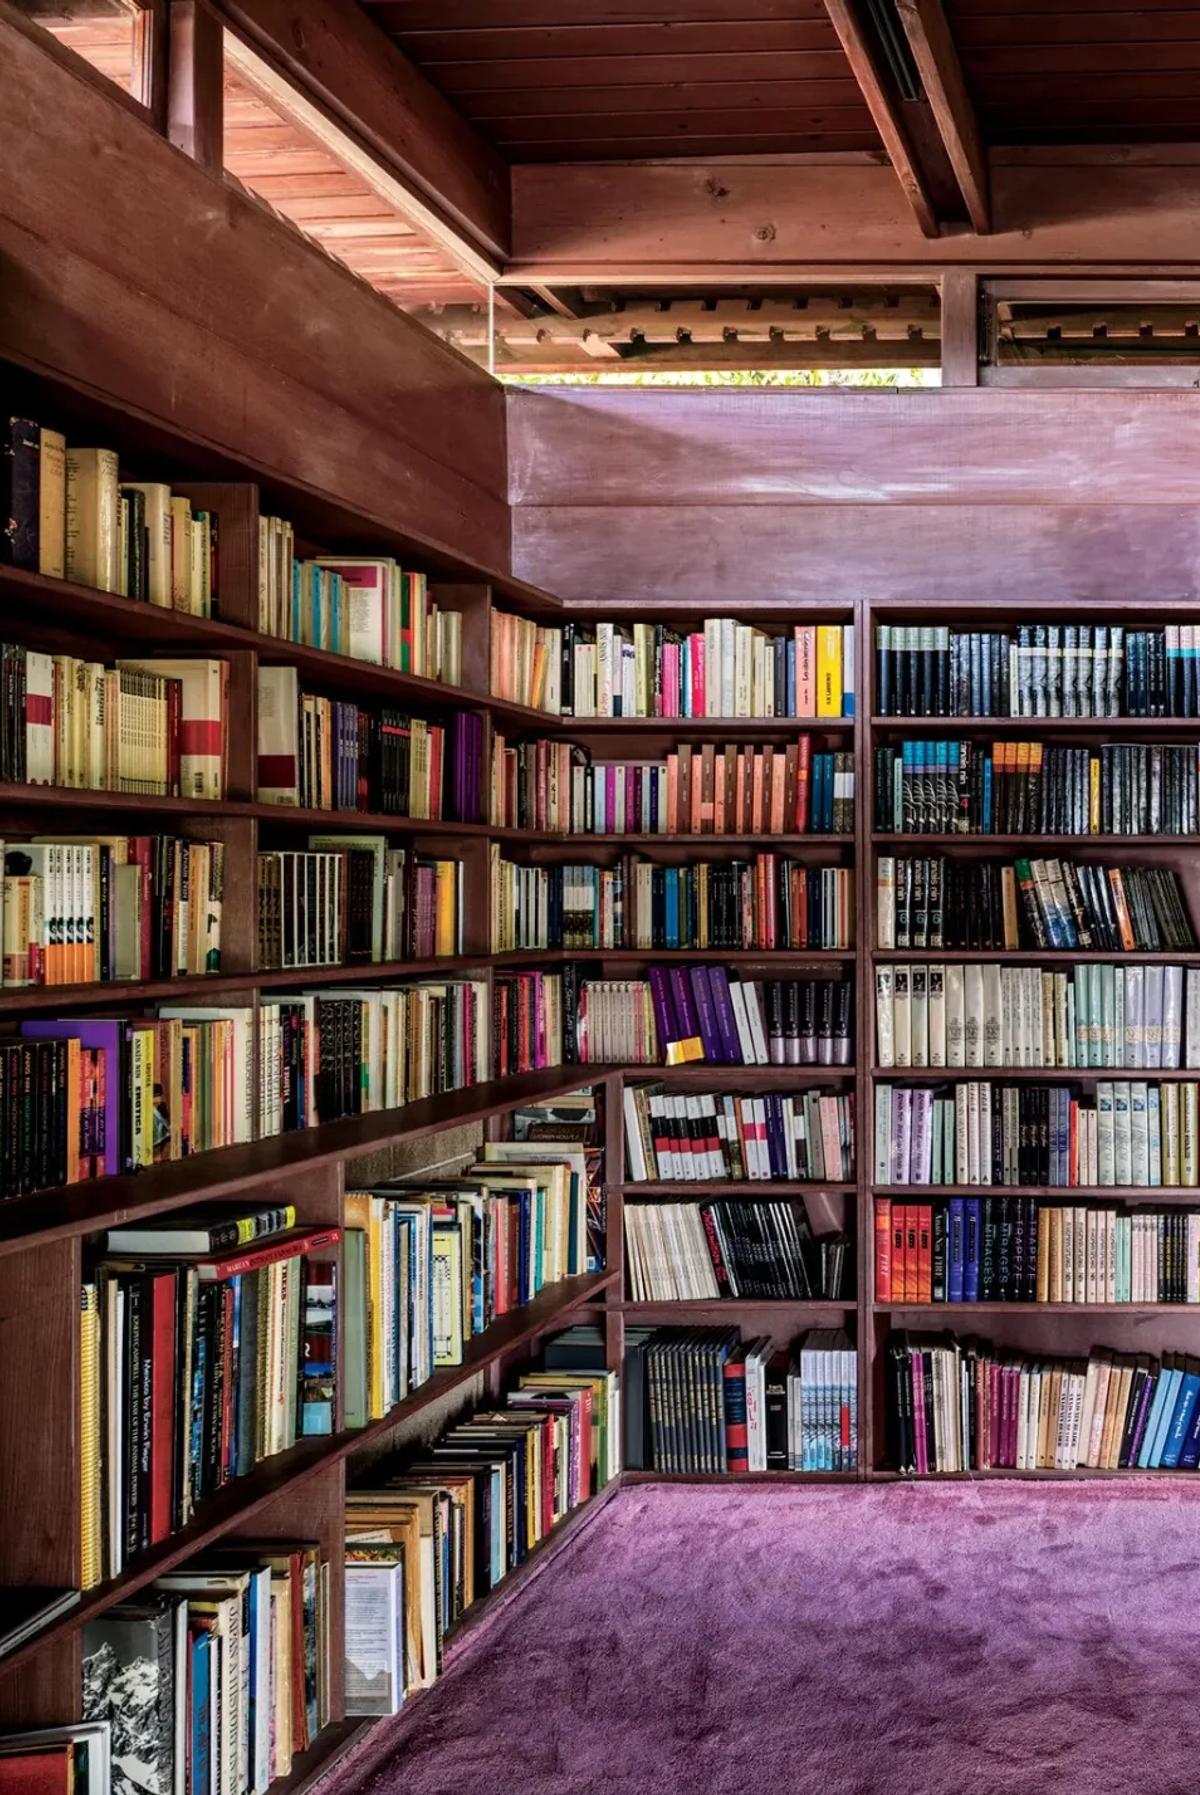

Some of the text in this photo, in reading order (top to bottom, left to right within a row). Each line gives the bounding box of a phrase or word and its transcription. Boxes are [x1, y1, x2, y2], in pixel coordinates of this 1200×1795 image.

[983, 1223, 992, 1284] MIRAGES
[999, 1222, 1008, 1283] MIRAGES
[1015, 1220, 1023, 1280] TRAPEZE
[1028, 1220, 1036, 1280] TRAPEZE
[934, 1255, 943, 1280] FIRE
[131, 1315, 139, 1341] JOSEPH
[142, 1358, 152, 1395] Mexico
[131, 1384, 139, 1400] THE
[142, 1397, 152, 1410] by
[131, 1401, 139, 1416] WAY
[131, 1417, 139, 1427] OF
[131, 1428, 139, 1444] THE
[142, 1412, 152, 1440] Erwin
[131, 1445, 139, 1474] ANIMAL
[131, 1475, 139, 1506] POWERS
[228, 1606, 239, 1795] JAPAN A HISTORY IN AR
